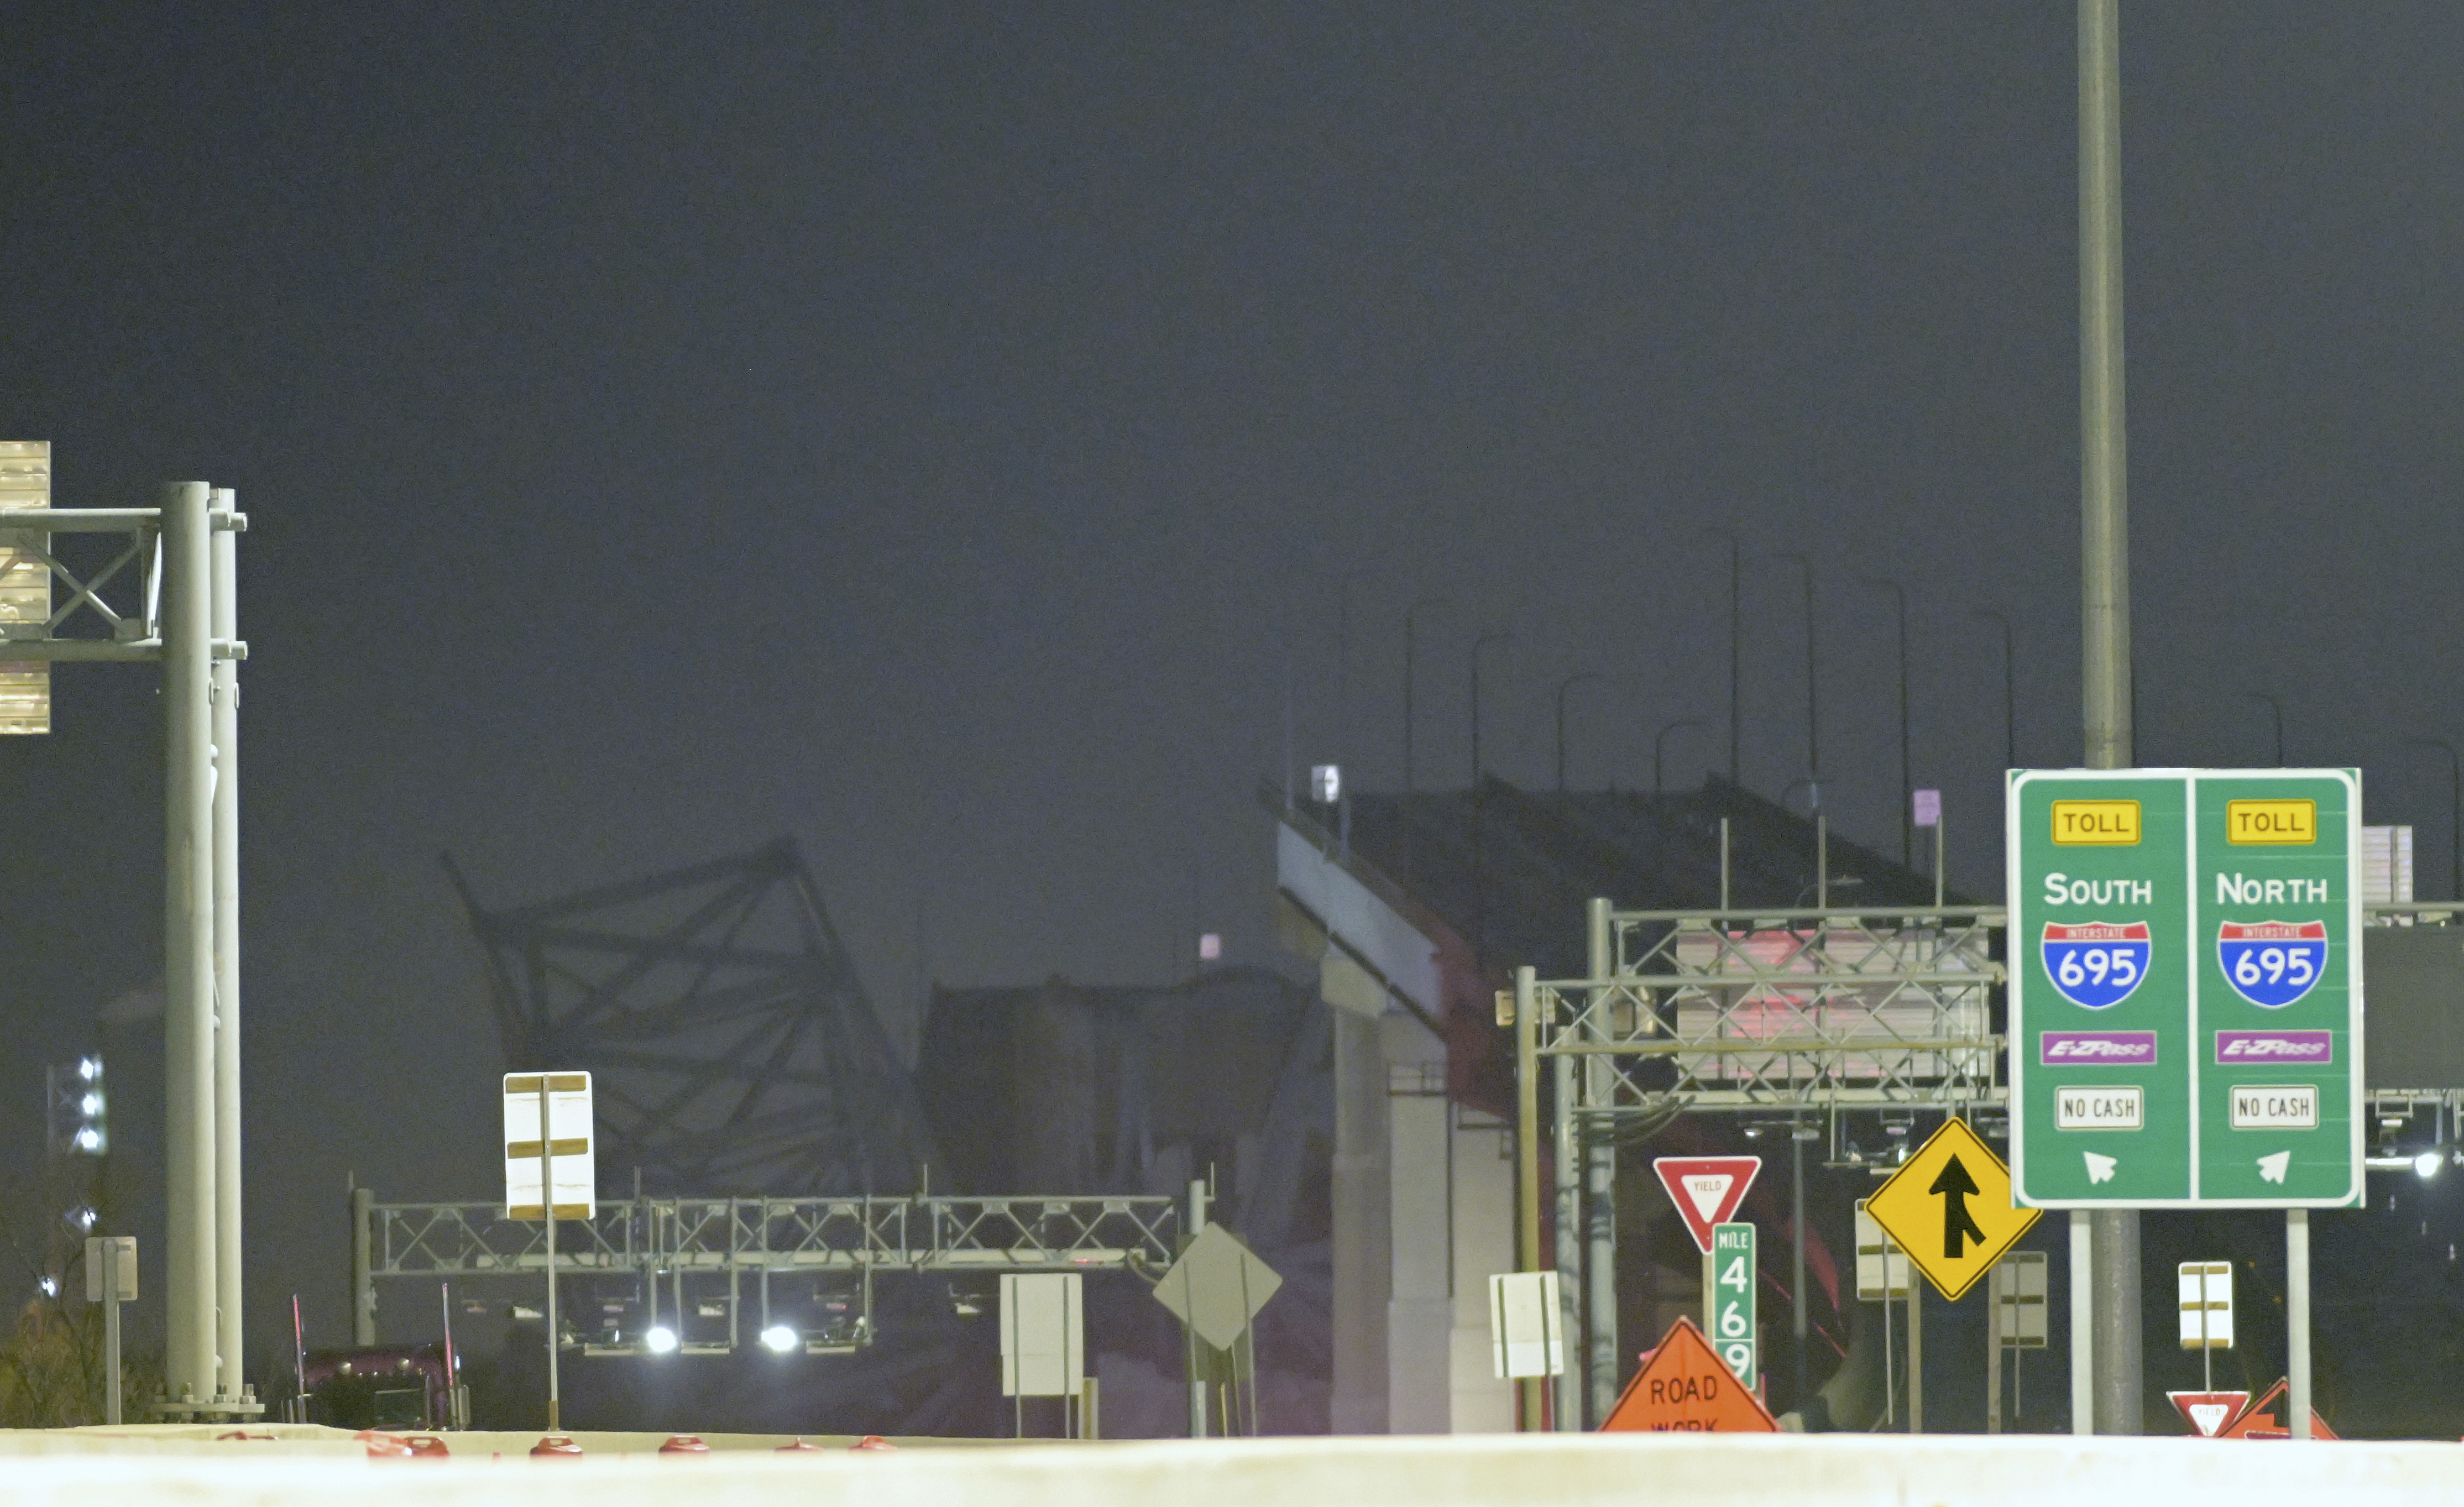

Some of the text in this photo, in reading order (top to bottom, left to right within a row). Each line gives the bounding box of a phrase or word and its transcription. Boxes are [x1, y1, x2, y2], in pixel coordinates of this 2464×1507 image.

[2063, 813, 2130, 832] TOLL
[2238, 813, 2305, 831] TOLL
[2044, 872, 2152, 905] SOUTH
[2216, 872, 2327, 905] NORTH
[2066, 928, 2125, 939] INTERSTATE
[2243, 927, 2301, 938] INTERSTATE
[2059, 949, 2137, 986] 695
[2236, 948, 2313, 986] 695
[2064, 1098, 2135, 1117] NO CASH
[2238, 1097, 2309, 1117] NO CASH
[1693, 1180, 1722, 1192] YIELD
[1718, 1232, 1748, 1249] MILE
[1651, 1375, 1718, 1405] ROAD
[2199, 1407, 2221, 1416] YIELD
